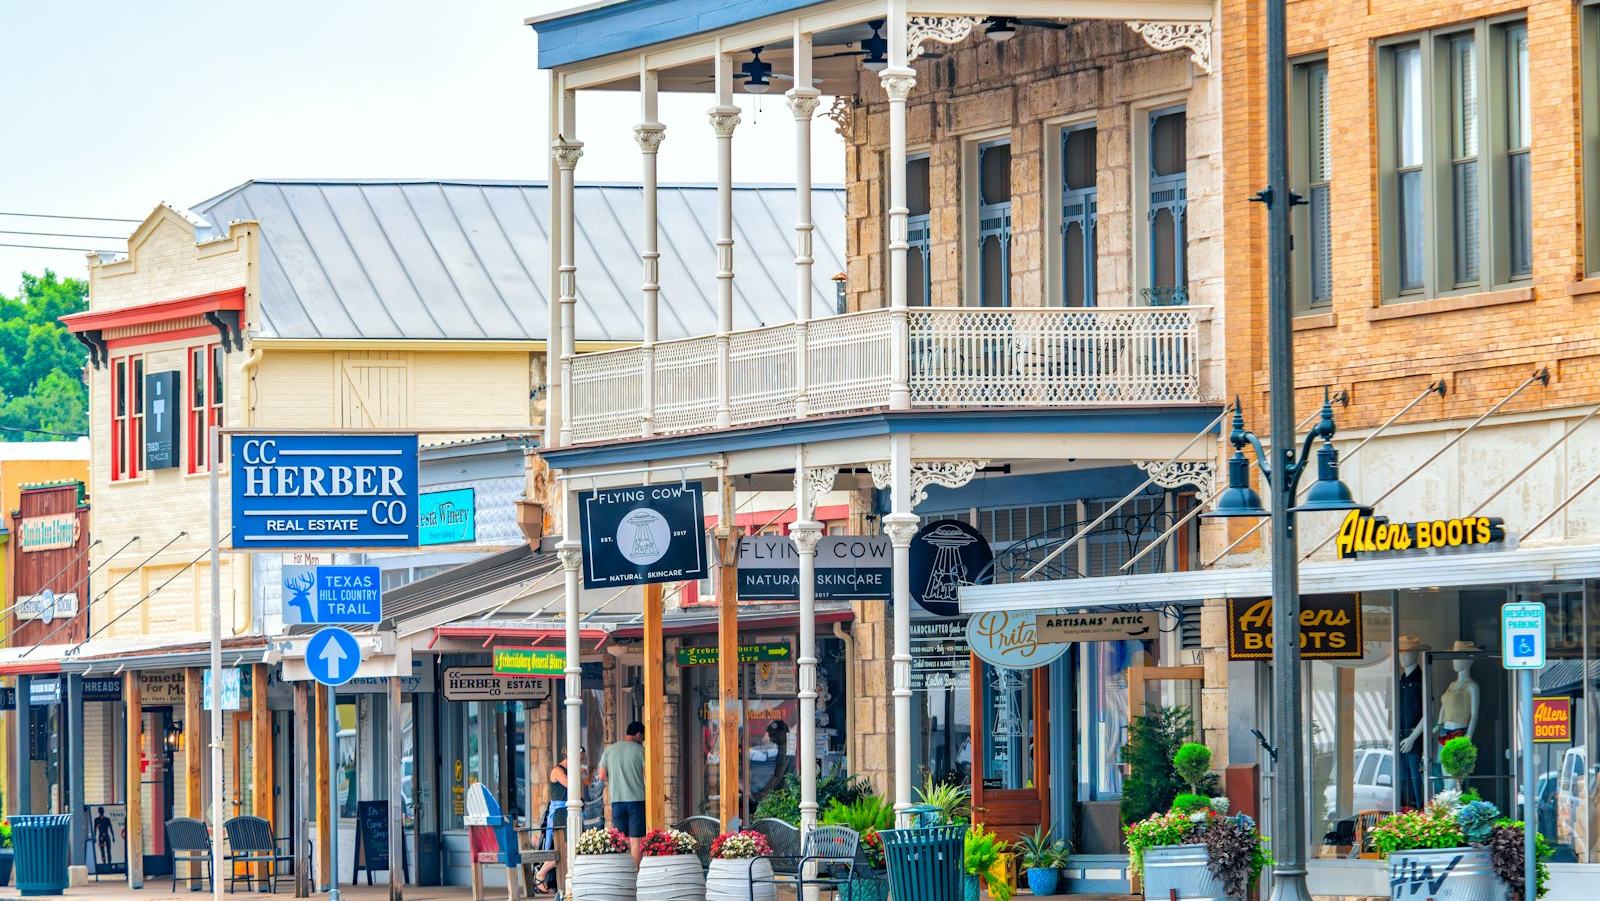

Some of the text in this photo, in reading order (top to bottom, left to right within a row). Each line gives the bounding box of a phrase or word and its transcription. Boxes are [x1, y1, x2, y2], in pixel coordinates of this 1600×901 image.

[243, 439, 277, 464] CC
[243, 466, 407, 497] HERBER
[599, 487, 682, 504] FLYING COW
[371, 500, 407, 525] CO
[266, 519, 359, 531] REAL ESTATE
[439, 501, 469, 538] Winery
[1336, 509, 1491, 560] Allens BOOTS
[740, 542, 887, 559] FLYIN COW
[325, 575, 372, 588] TEXAS
[609, 569, 683, 582] NATURAL SKINCARE
[746, 574, 882, 585] NATURA SKINCARE
[320, 589, 377, 601] HILL COUNTRY
[327, 603, 371, 615] TRAIL
[1238, 598, 1351, 631] Aens
[1505, 609, 1541, 618] RESERVED
[1046, 615, 1145, 628] ARTISANS' ATTIC
[1508, 621, 1539, 629] PARKING
[977, 610, 1037, 657] Pritz
[689, 655, 759, 665] Souirs
[141, 672, 186, 684] ometh
[449, 671, 461, 679] CC
[146, 683, 186, 696] For Me
[449, 679, 501, 689] HERBER
[507, 680, 543, 689] ESTATE
[489, 688, 501, 696] CO
[1534, 702, 1568, 724] Allens
[1535, 725, 1567, 737] BOOTS
